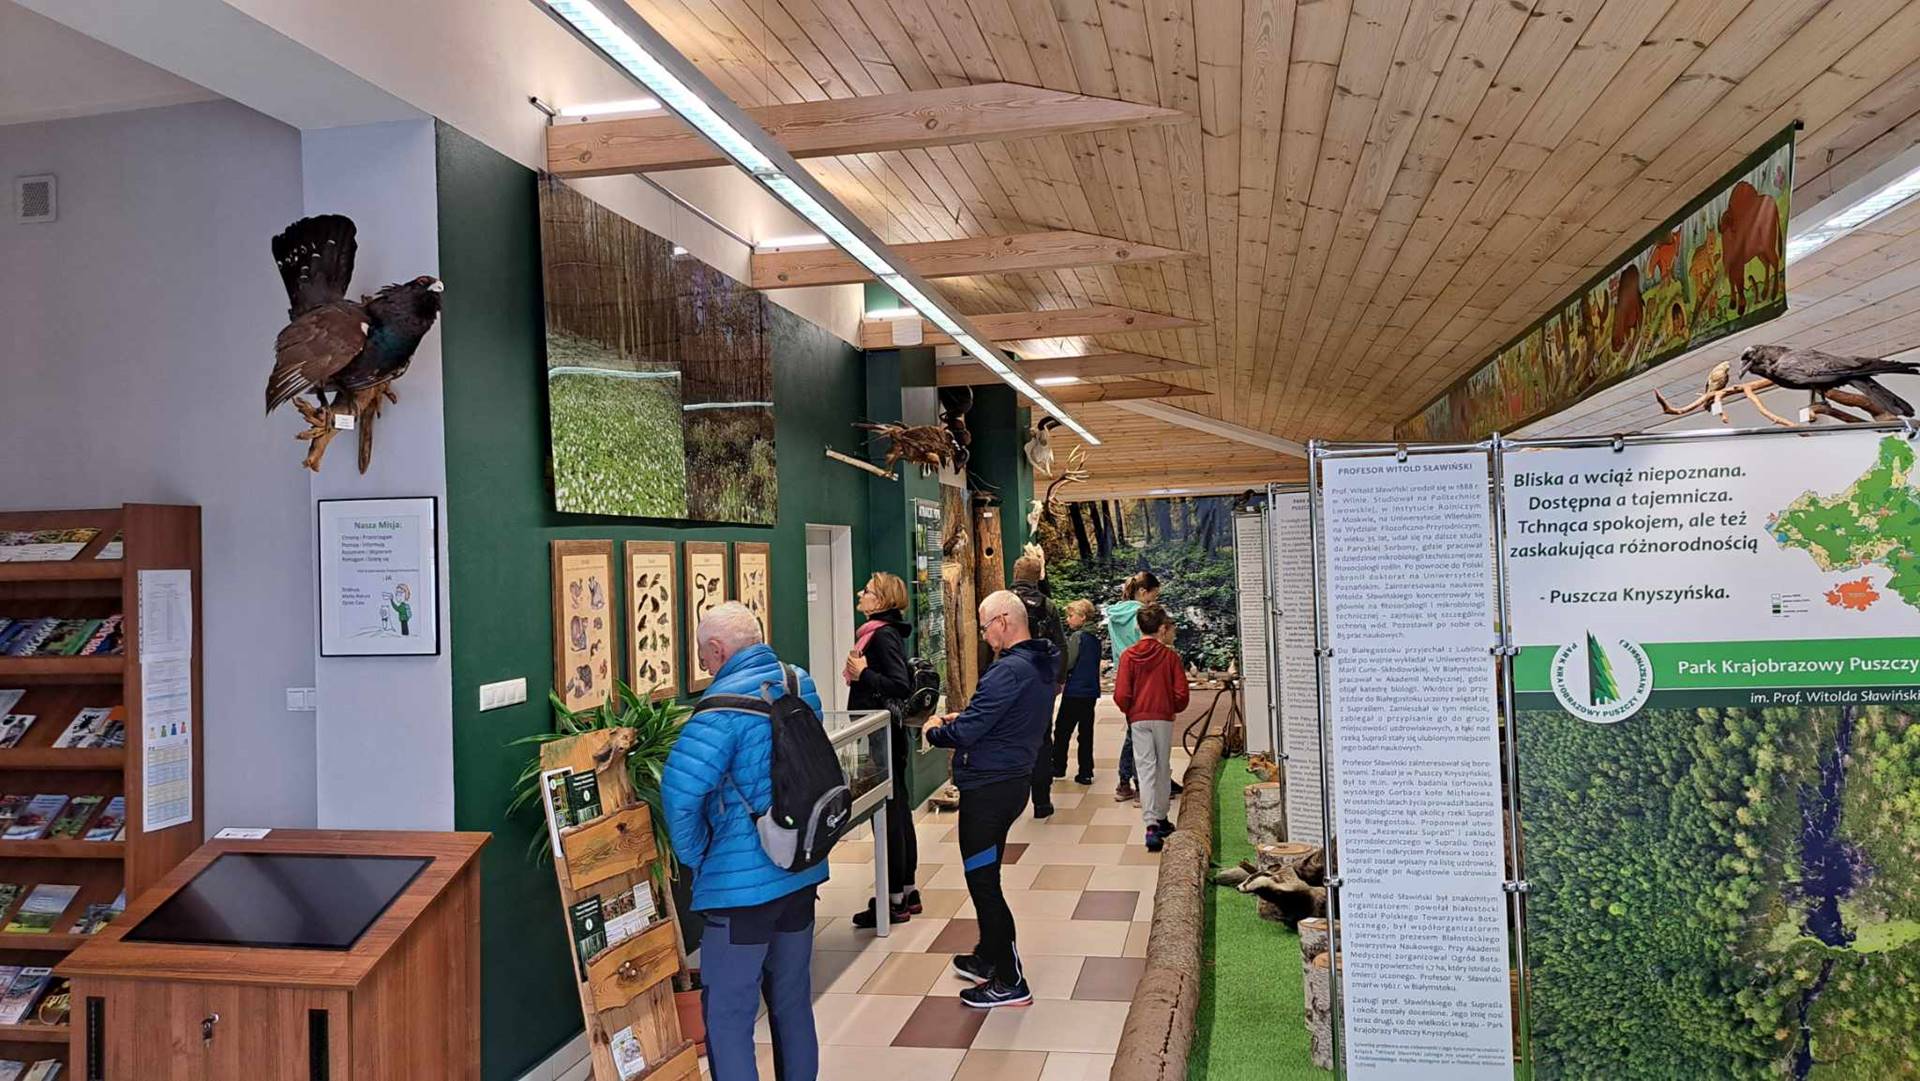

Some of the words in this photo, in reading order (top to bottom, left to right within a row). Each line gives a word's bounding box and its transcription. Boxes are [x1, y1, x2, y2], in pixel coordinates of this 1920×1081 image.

[1337, 466, 1383, 474] PROFESOR
[1386, 465, 1421, 473] WITOLD
[1423, 461, 1472, 471] SŁAWIŃSKI
[1514, 472, 1564, 487] Bliska
[1569, 475, 1579, 485] a
[1584, 469, 1633, 487] wciąż
[1638, 466, 1746, 484] niepoznana.
[1528, 494, 1611, 513] Dostępna
[1616, 496, 1626, 506] a
[1632, 488, 1733, 508] tajemnicza.
[1518, 518, 1588, 536] Tchnąca
[1592, 515, 1684, 534] spokojem,
[1688, 512, 1715, 527] ale
[1720, 510, 1747, 526] też
[1510, 541, 1614, 560] zaskakująca
[1619, 535, 1758, 555] różnorodnością
[1550, 590, 1617, 604] Puszcza
[1623, 585, 1730, 604] Knyszyńska.
[1557, 642, 1579, 667] PARK
[1678, 660, 1717, 674] Park
[1722, 658, 1844, 676] Krajobrazowy
[1850, 657, 1919, 674] Puszczy
[1555, 665, 1601, 717] KRAJOBRAZOWY
[1750, 692, 1770, 703] im.
[1773, 691, 1803, 705] Prof.
[1806, 690, 1857, 702] Witolda
[1602, 695, 1639, 718] PUSZCZY
